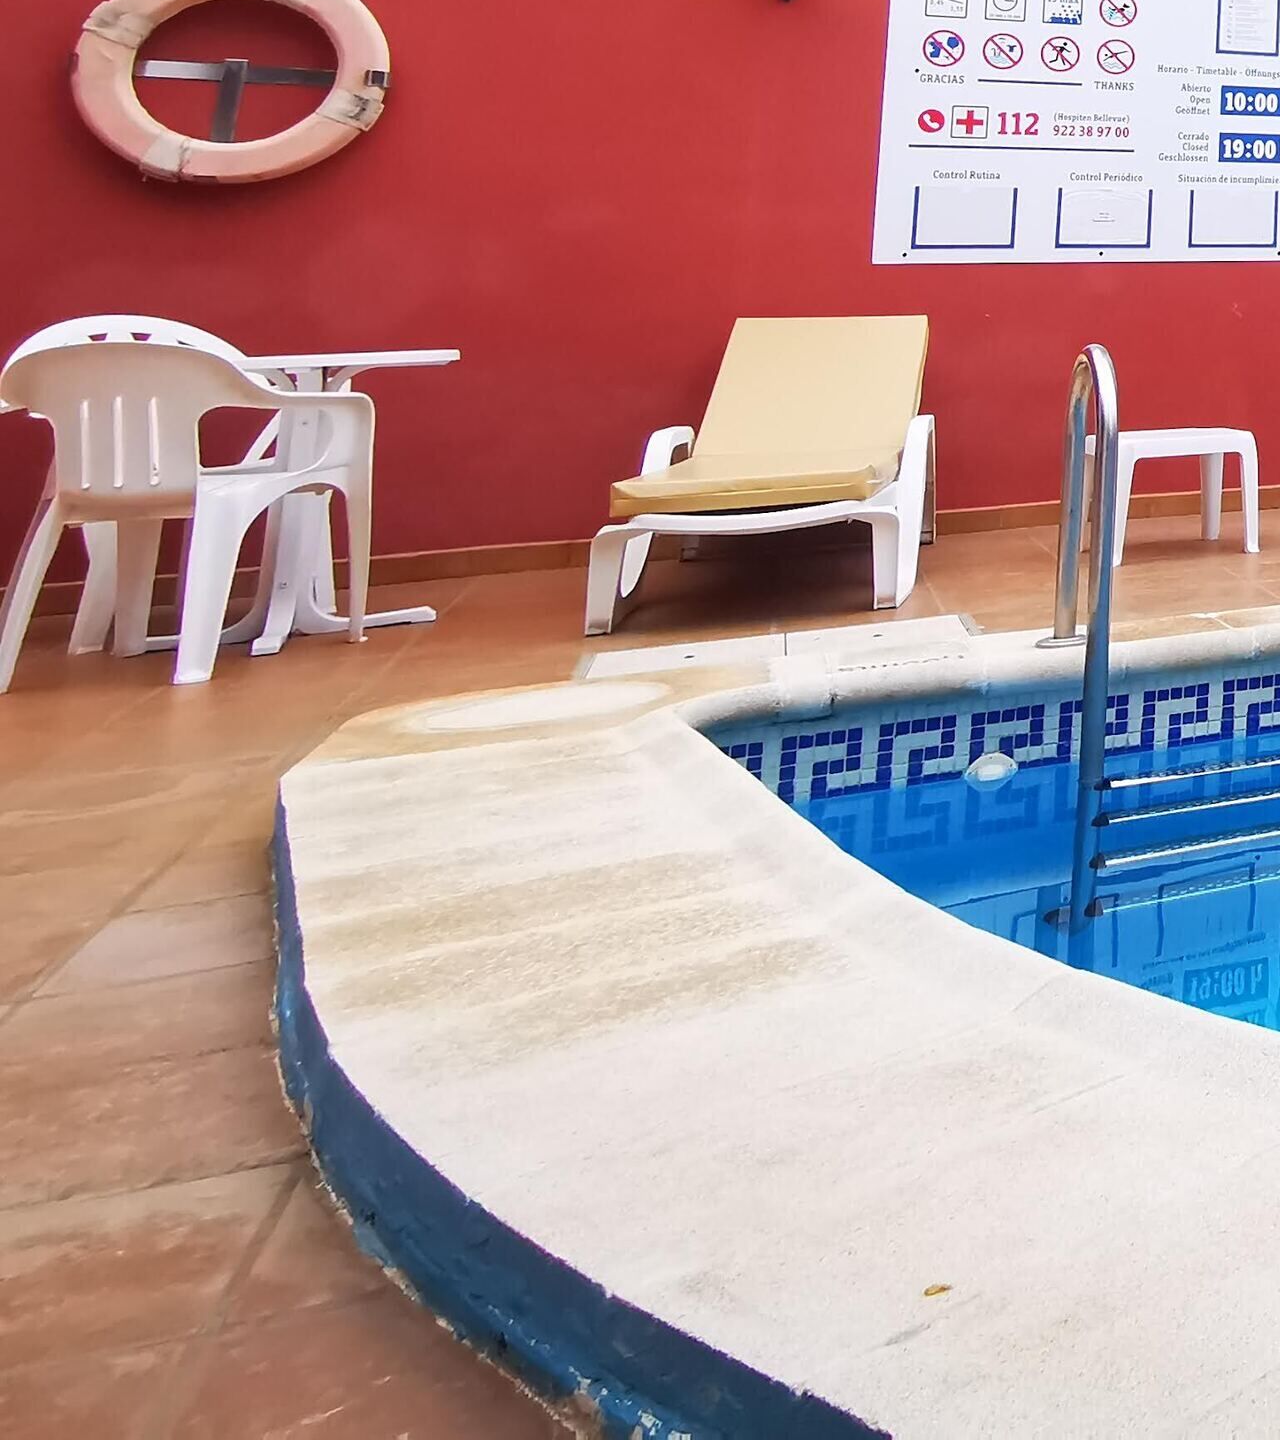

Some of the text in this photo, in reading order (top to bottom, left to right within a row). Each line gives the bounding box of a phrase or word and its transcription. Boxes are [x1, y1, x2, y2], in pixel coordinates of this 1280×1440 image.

[1157, 64, 1189, 74] Horario
[1195, 66, 1237, 76] Timetable
[919, 74, 966, 84] GRACIAS
[1094, 81, 1135, 92] THANKS
[1180, 83, 1212, 93] Abierto
[1189, 95, 1211, 106] Open
[1225, 91, 1279, 113] 10:00
[997, 112, 1040, 136] 112
[1053, 124, 1130, 138] 922 38 97 00
[1177, 131, 1210, 141] Cerrado
[1182, 142, 1209, 152] Closed
[1223, 138, 1277, 160] 19:00
[1158, 153, 1209, 162] Geschlossen
[933, 170, 1001, 180] Control Rutina
[1069, 172, 1143, 182] Control Periódico
[1218, 174, 1229, 184] de
